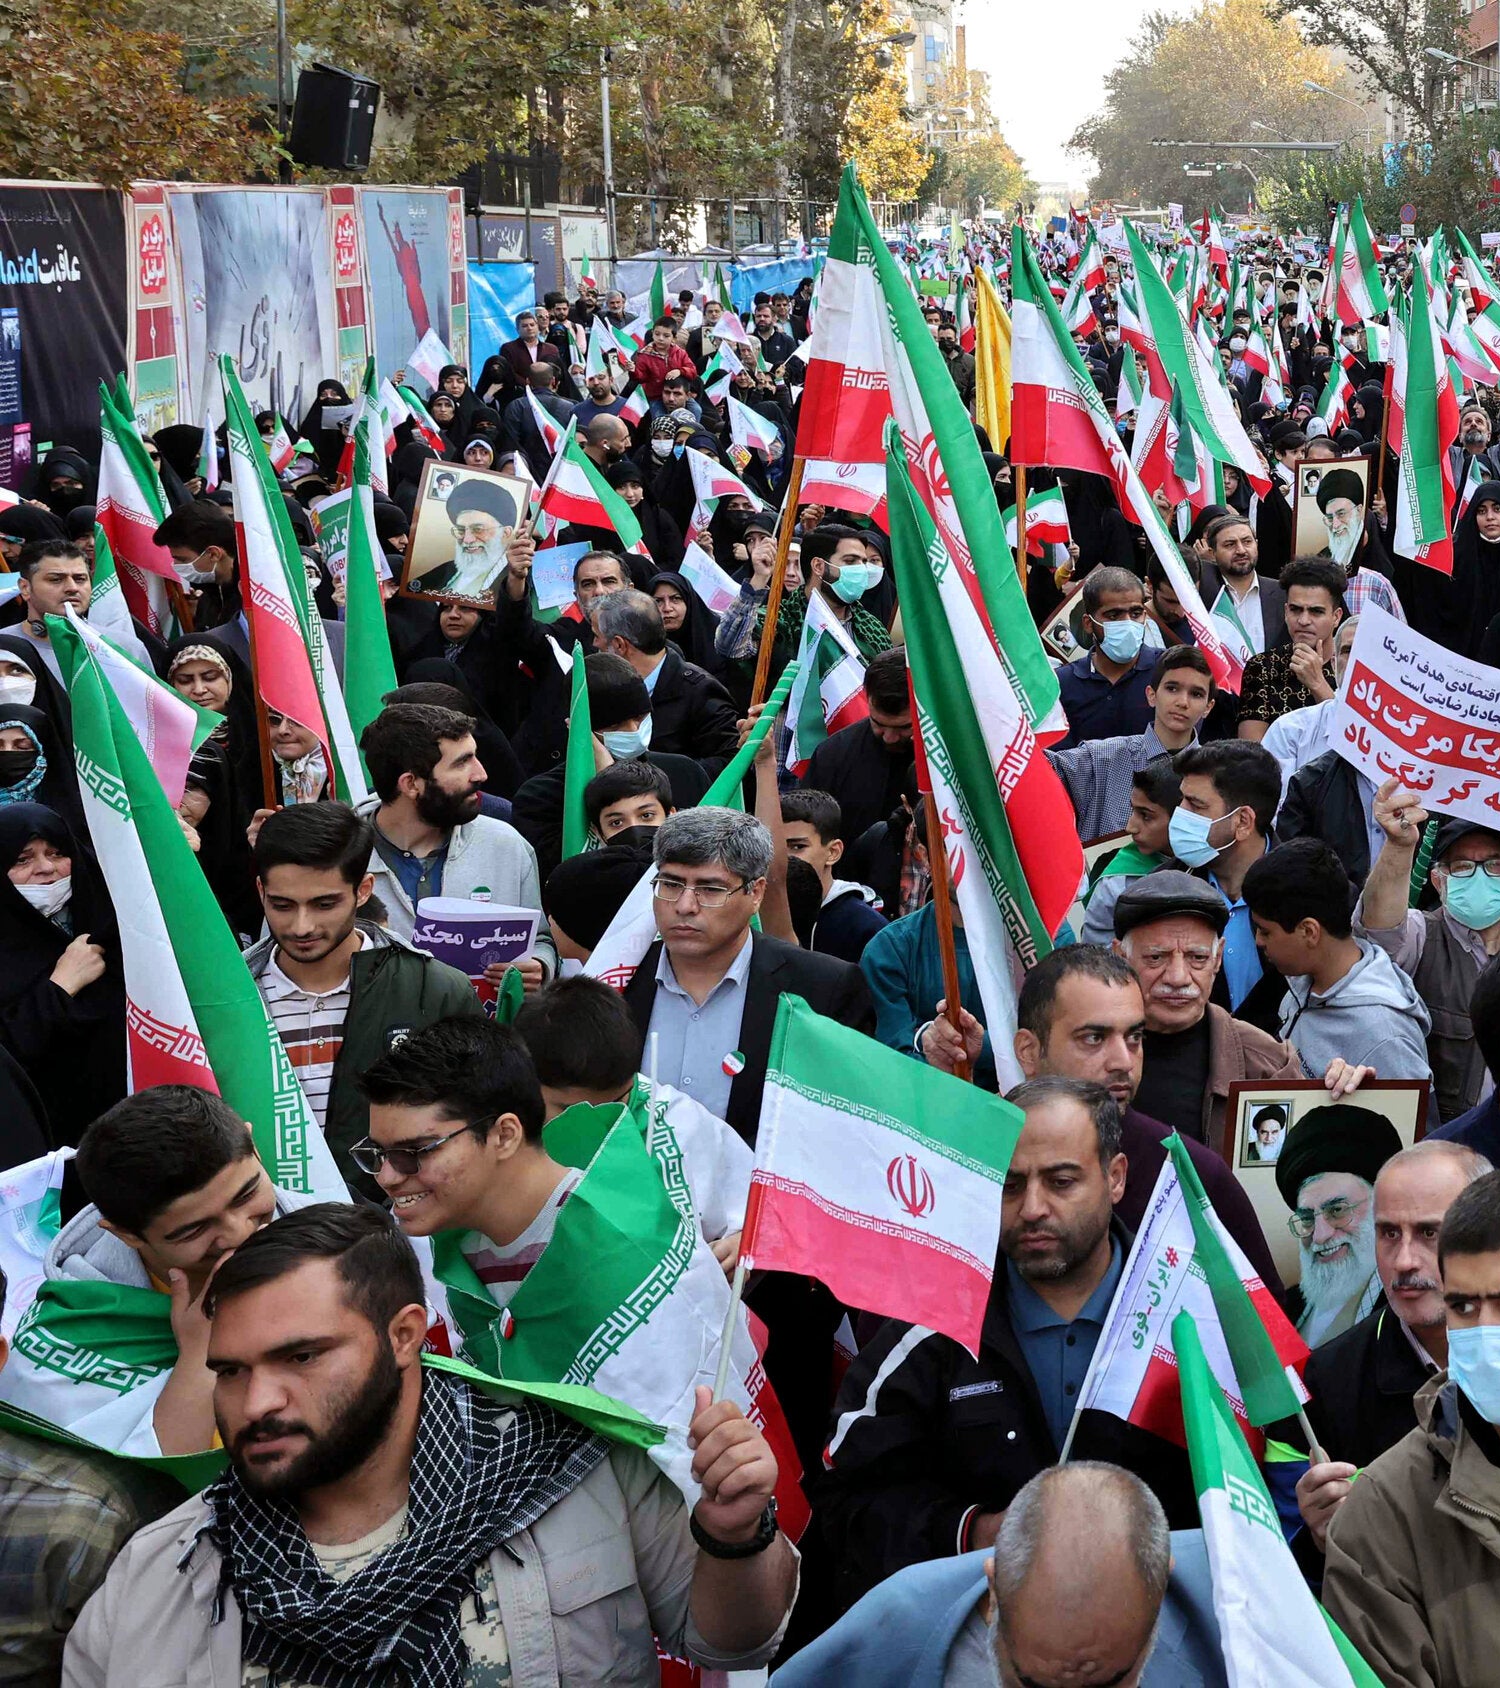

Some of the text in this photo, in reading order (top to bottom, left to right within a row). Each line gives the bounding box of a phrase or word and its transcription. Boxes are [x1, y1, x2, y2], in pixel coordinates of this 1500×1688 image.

[38, 244, 81, 293] عاقبت
[1382, 636, 1418, 666] آمریکا
[1400, 674, 1424, 695] است
[1416, 661, 1446, 684] هدف
[1353, 678, 1383, 720] باد
[1444, 680, 1500, 704] اقتصادی
[1422, 693, 1479, 719] نارضایتی
[1343, 722, 1372, 763] باد
[1435, 780, 1482, 805] گر
[412, 923, 528, 949] سیلی محکم
